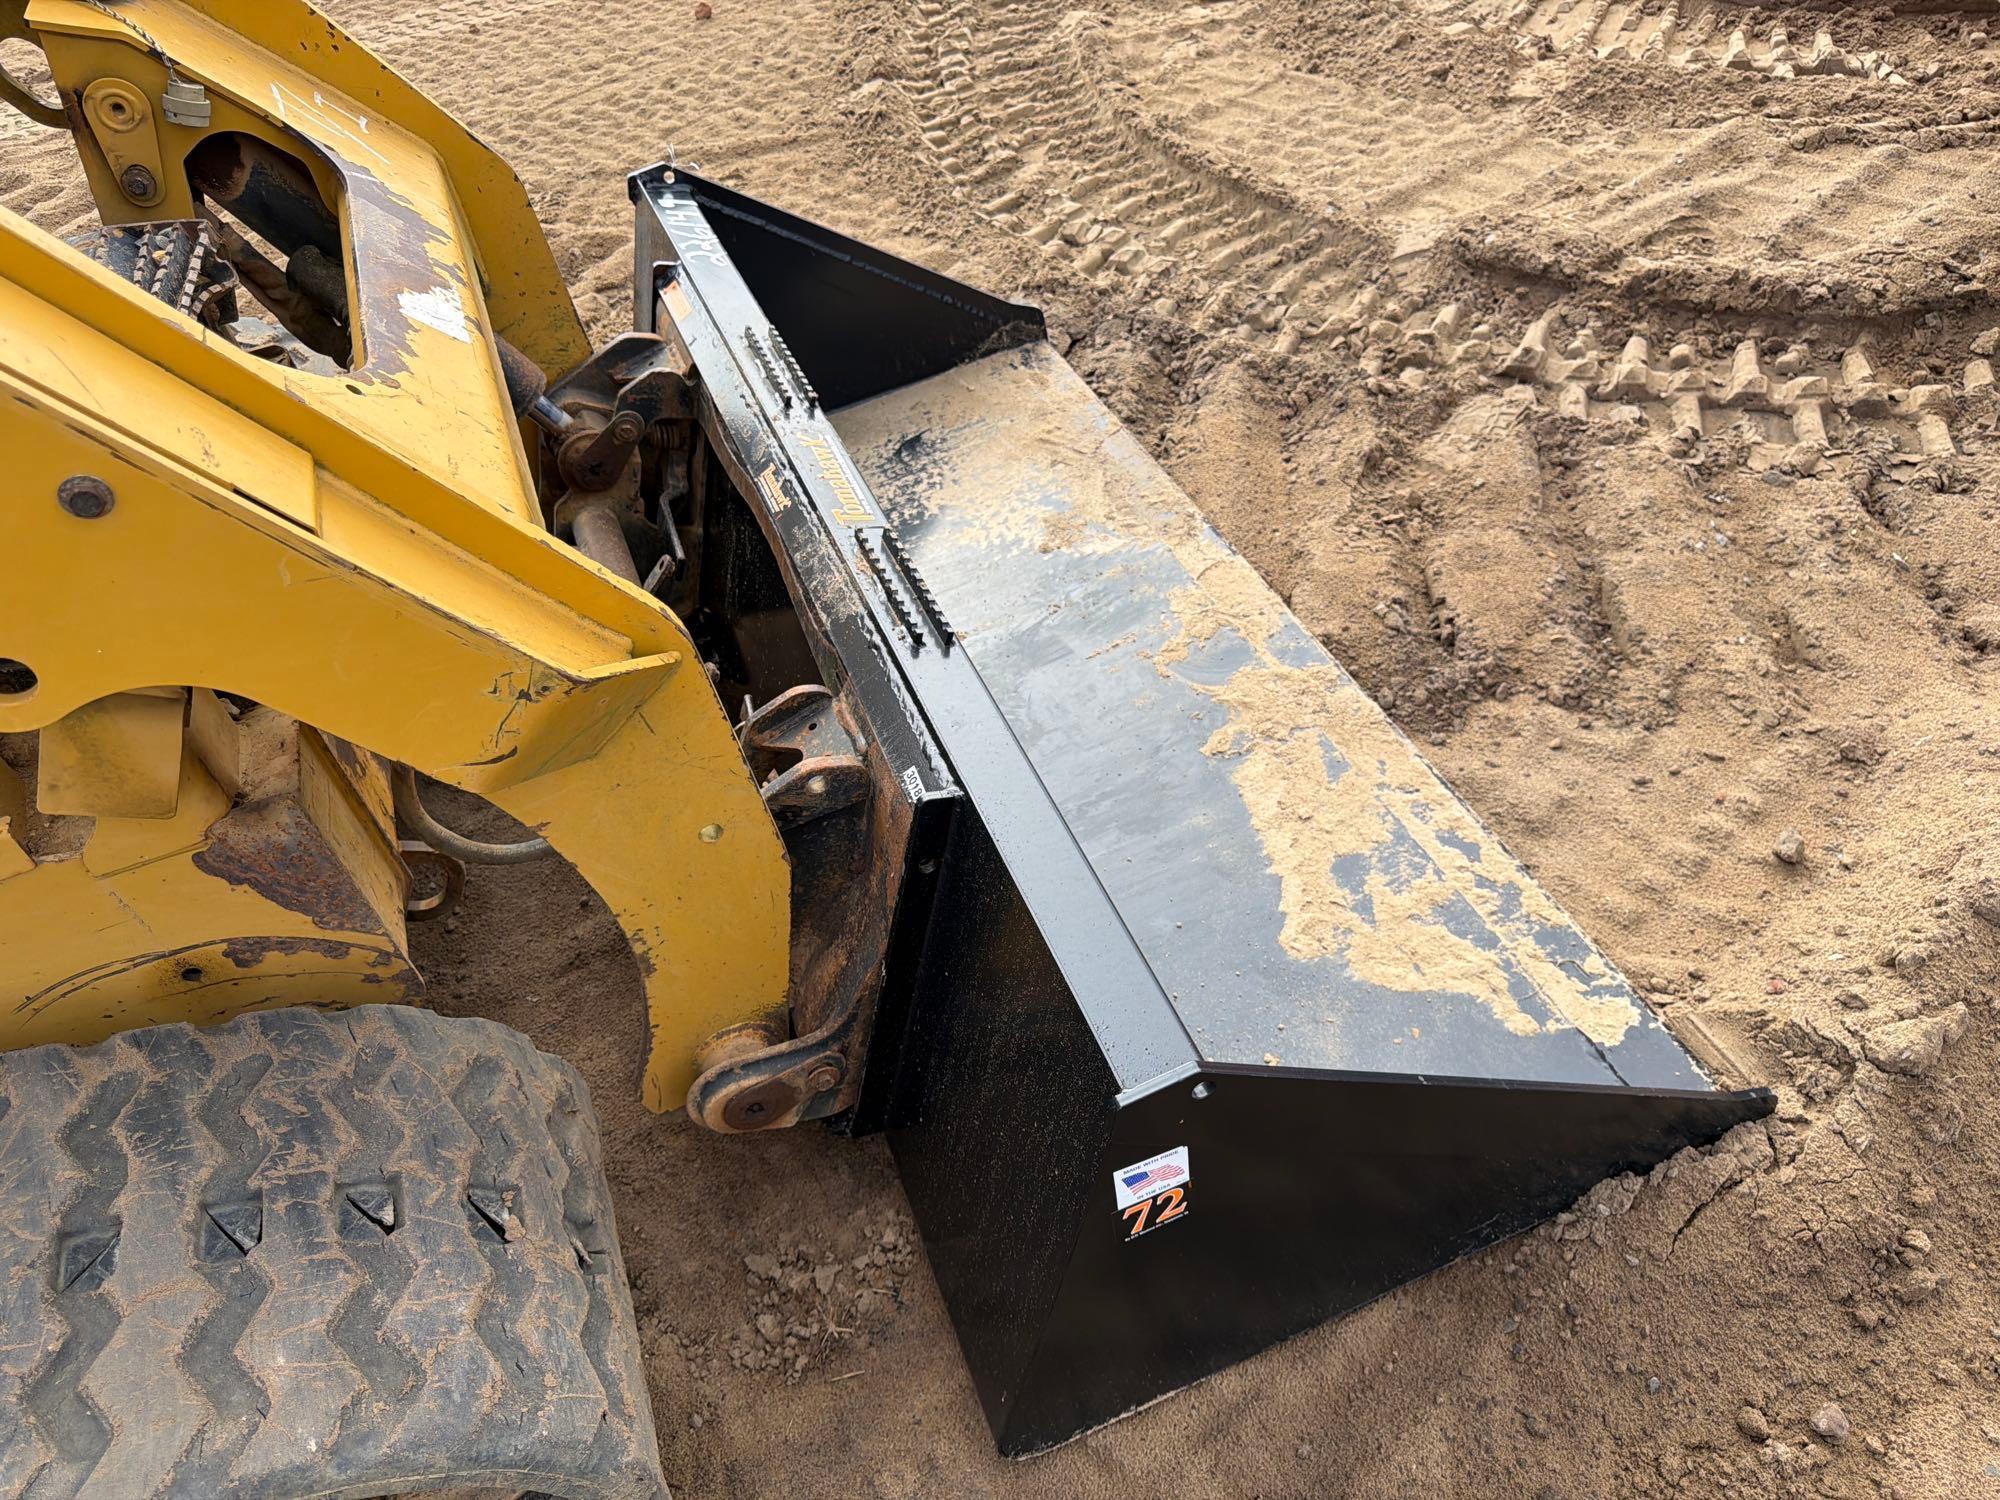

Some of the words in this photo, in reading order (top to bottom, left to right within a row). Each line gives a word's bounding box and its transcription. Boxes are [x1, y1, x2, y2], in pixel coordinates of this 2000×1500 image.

[796, 432, 875, 525] Tomahawk
[906, 770, 923, 797] 3018
[1123, 1165, 1141, 1175] MADE
[1143, 1158, 1159, 1167] WITH
[1122, 1187, 1188, 1235] 72
